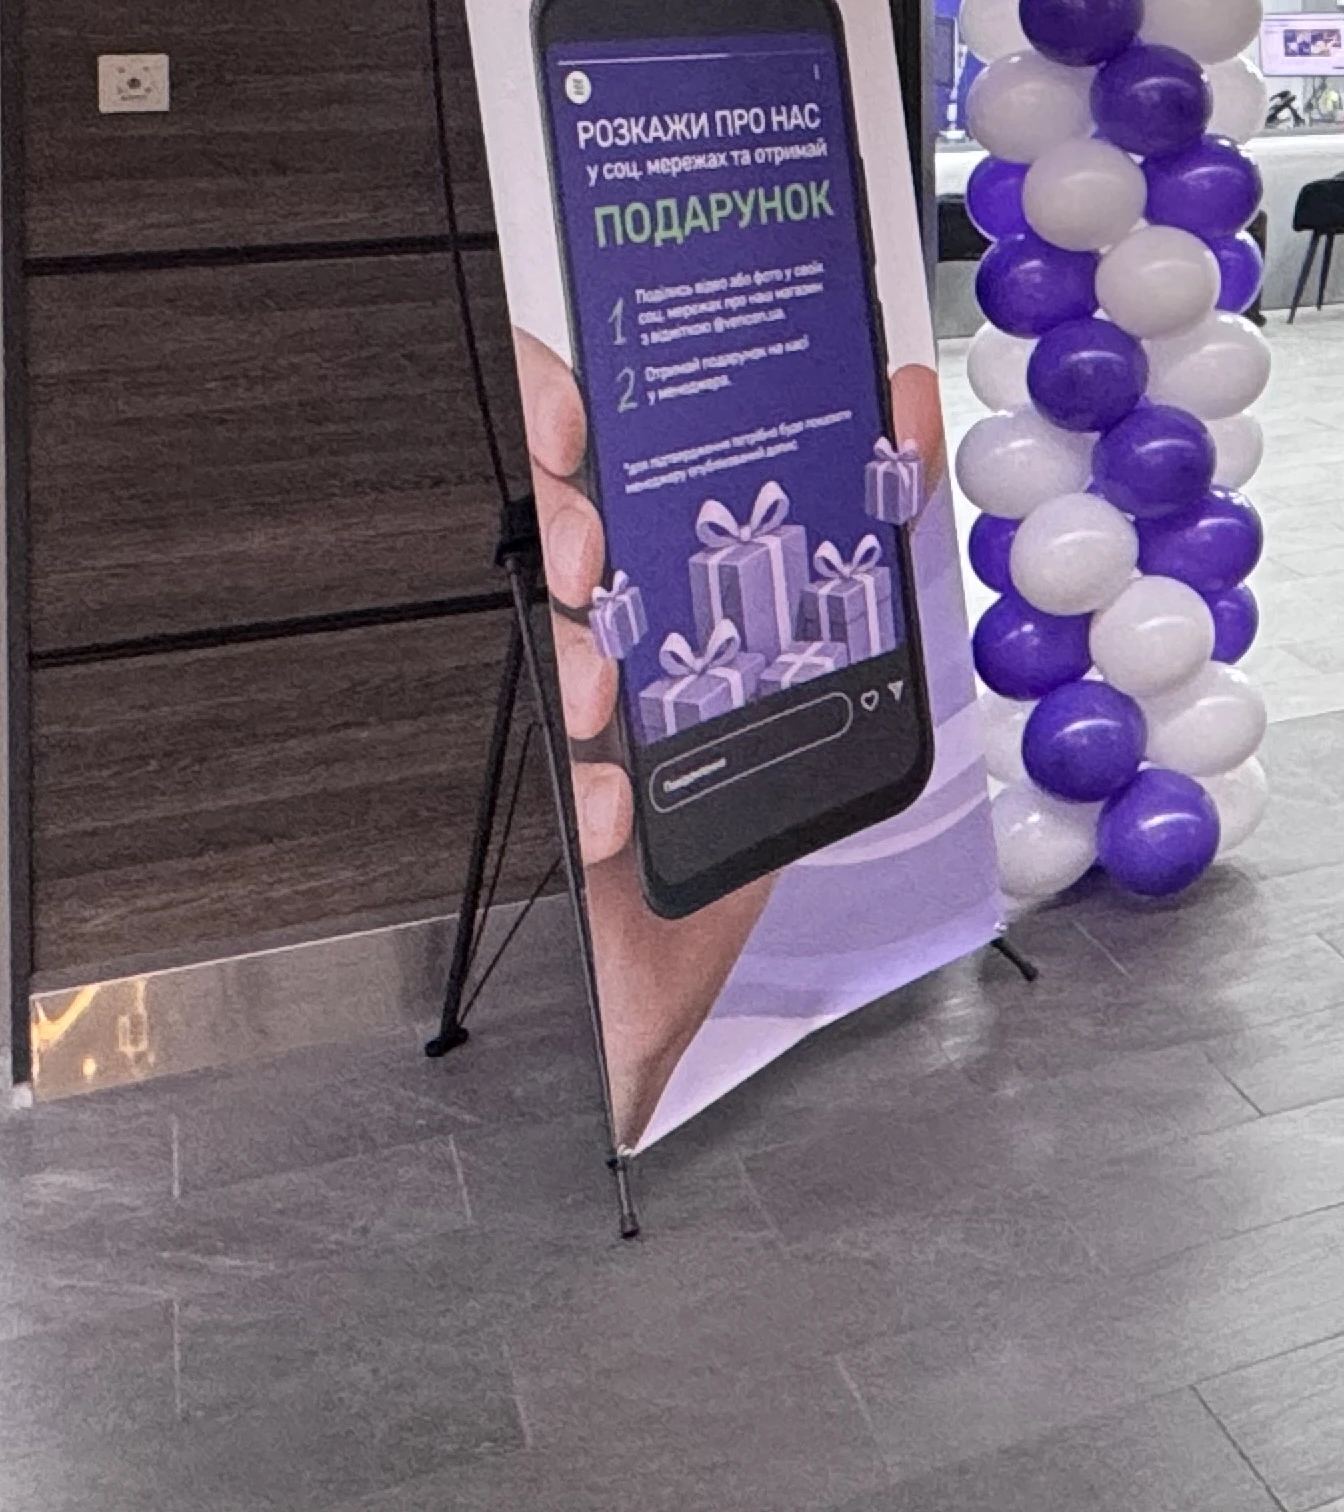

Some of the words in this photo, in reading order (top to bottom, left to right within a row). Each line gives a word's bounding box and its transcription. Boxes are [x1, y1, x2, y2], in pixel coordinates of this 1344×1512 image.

[577, 111, 710, 149] РОЗКАЖИ
[714, 106, 766, 138] ПРО
[770, 103, 822, 132] НАС
[586, 163, 599, 187] у
[602, 161, 643, 181] соц.
[646, 152, 728, 177] мережах
[730, 148, 751, 166] та
[755, 137, 828, 166] отримай
[594, 179, 835, 248] ПОДАРУНОК
[608, 297, 628, 346] 1
[615, 366, 638, 414] 2
